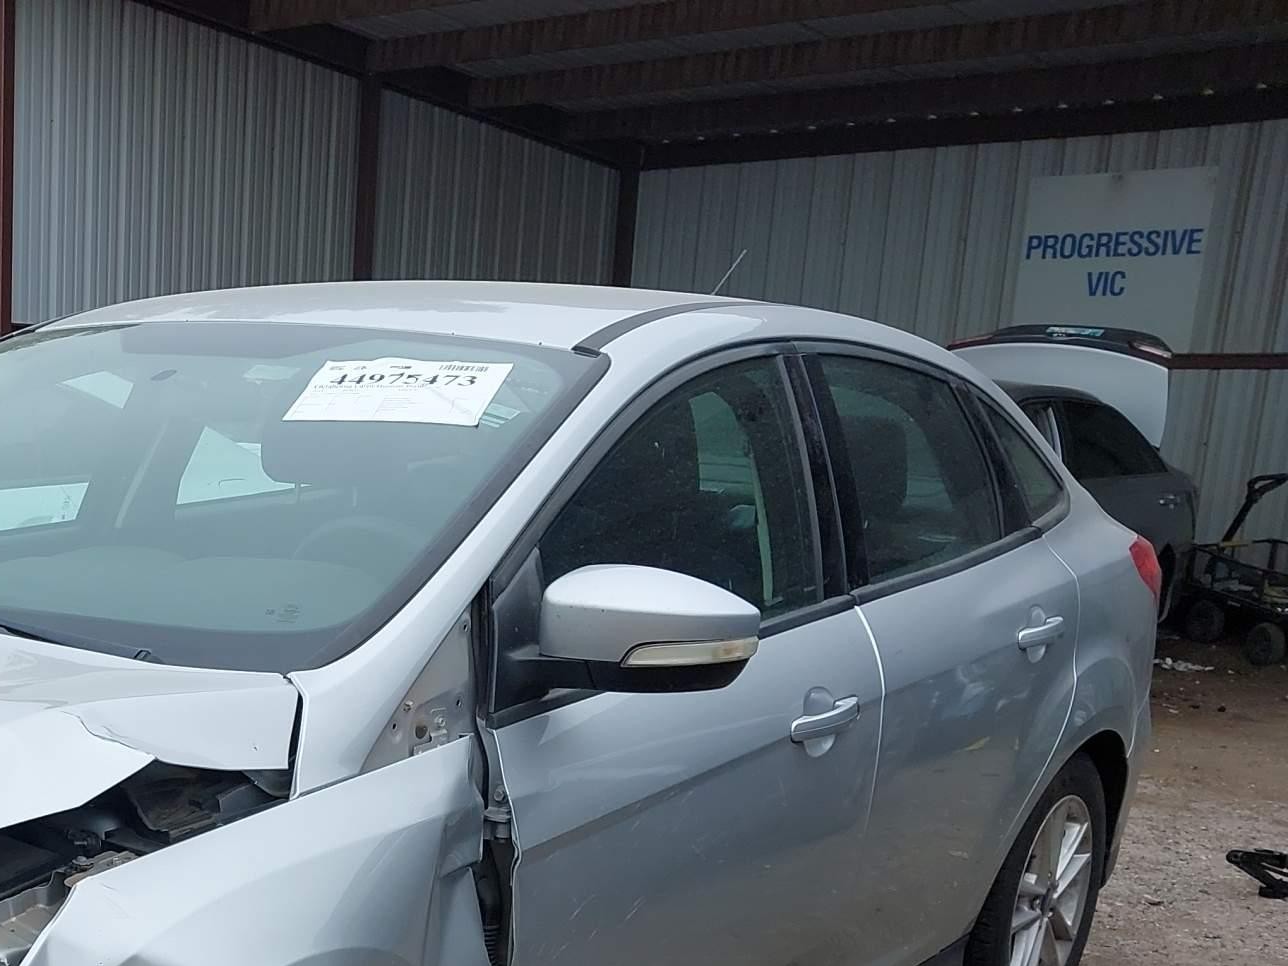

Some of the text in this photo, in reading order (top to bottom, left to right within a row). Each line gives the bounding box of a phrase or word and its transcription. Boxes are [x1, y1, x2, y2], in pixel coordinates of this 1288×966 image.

[1026, 228, 1204, 260] PROGRESSIVE
[1087, 270, 1126, 297] VIC
[329, 372, 478, 387] 44975473
